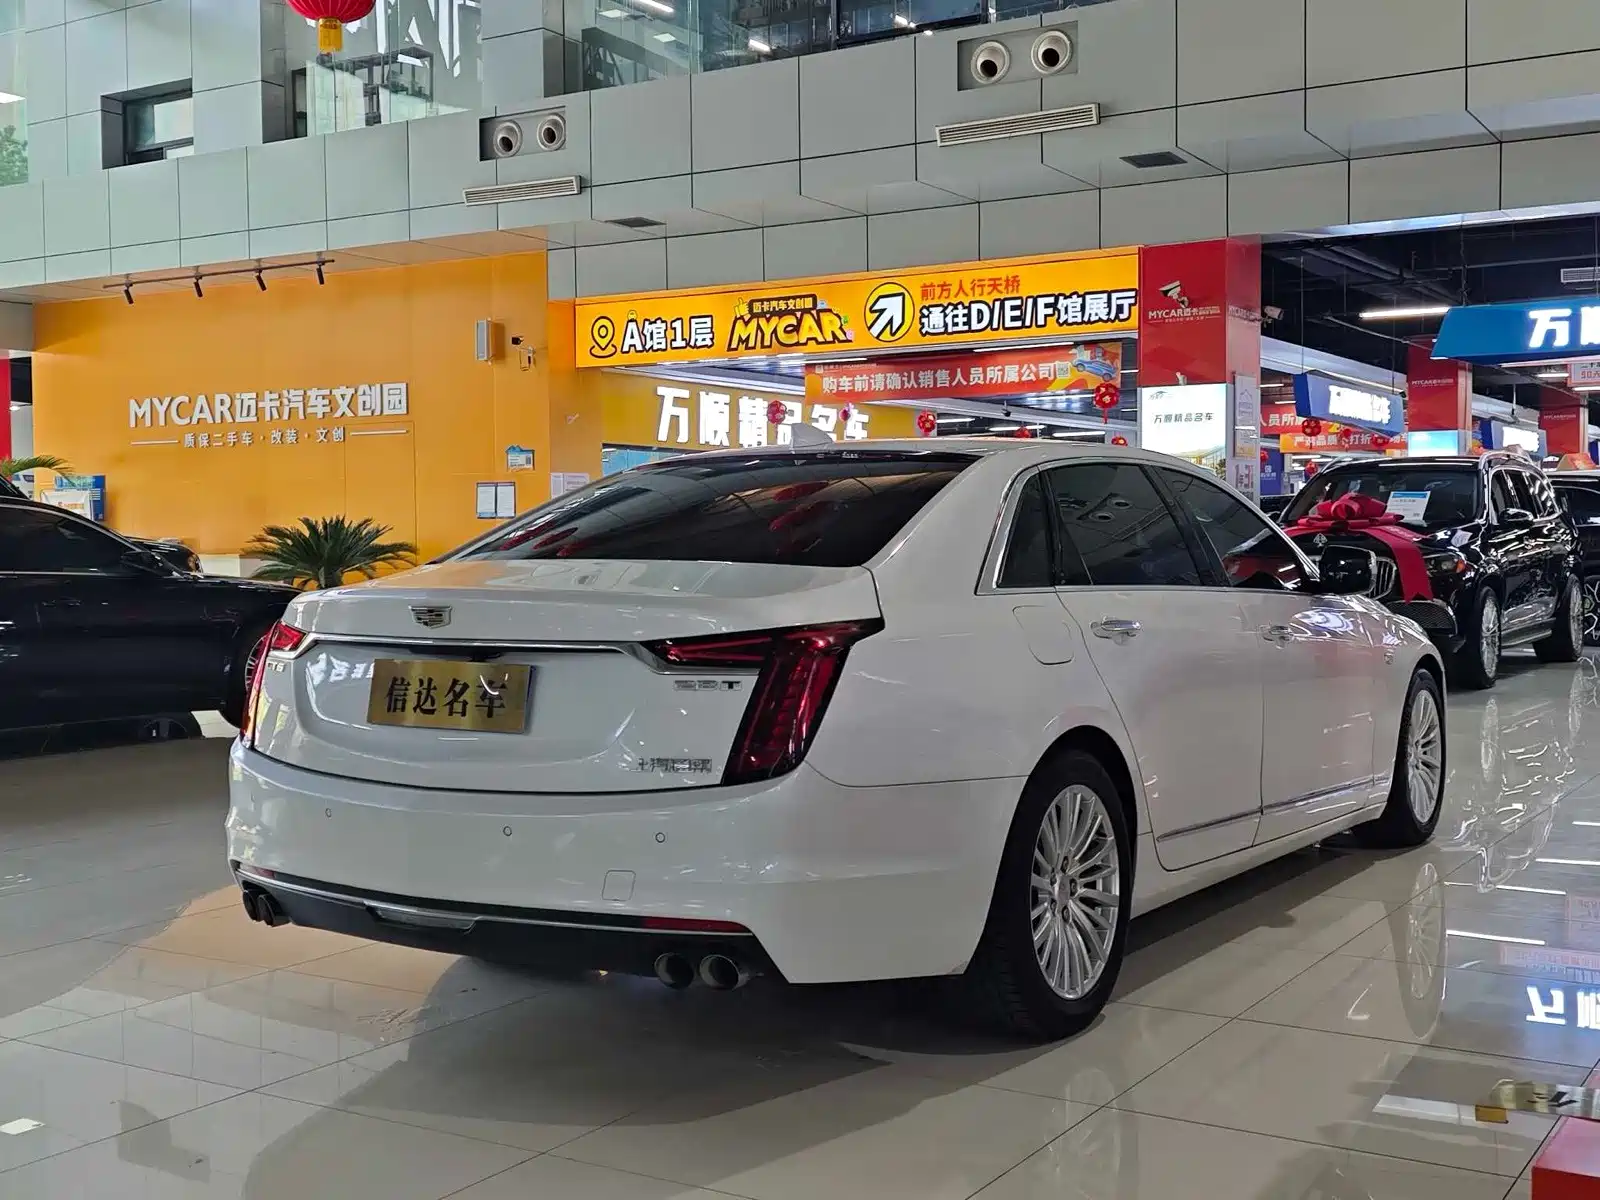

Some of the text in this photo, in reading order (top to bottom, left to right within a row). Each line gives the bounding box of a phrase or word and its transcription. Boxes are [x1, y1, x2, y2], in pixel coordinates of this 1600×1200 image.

[752, 297, 813, 313] 迈卡汽车文创园
[921, 275, 1020, 300] 前方人行天桥
[730, 312, 850, 350] MYCAR
[921, 290, 1136, 335] 通往D/E/F馆展厅
[822, 363, 1055, 393] 购车前请确认销售人员所属公司
[129, 382, 408, 428] MYCAR迈卡汽车文创园
[386, 676, 508, 718] 信达名车
